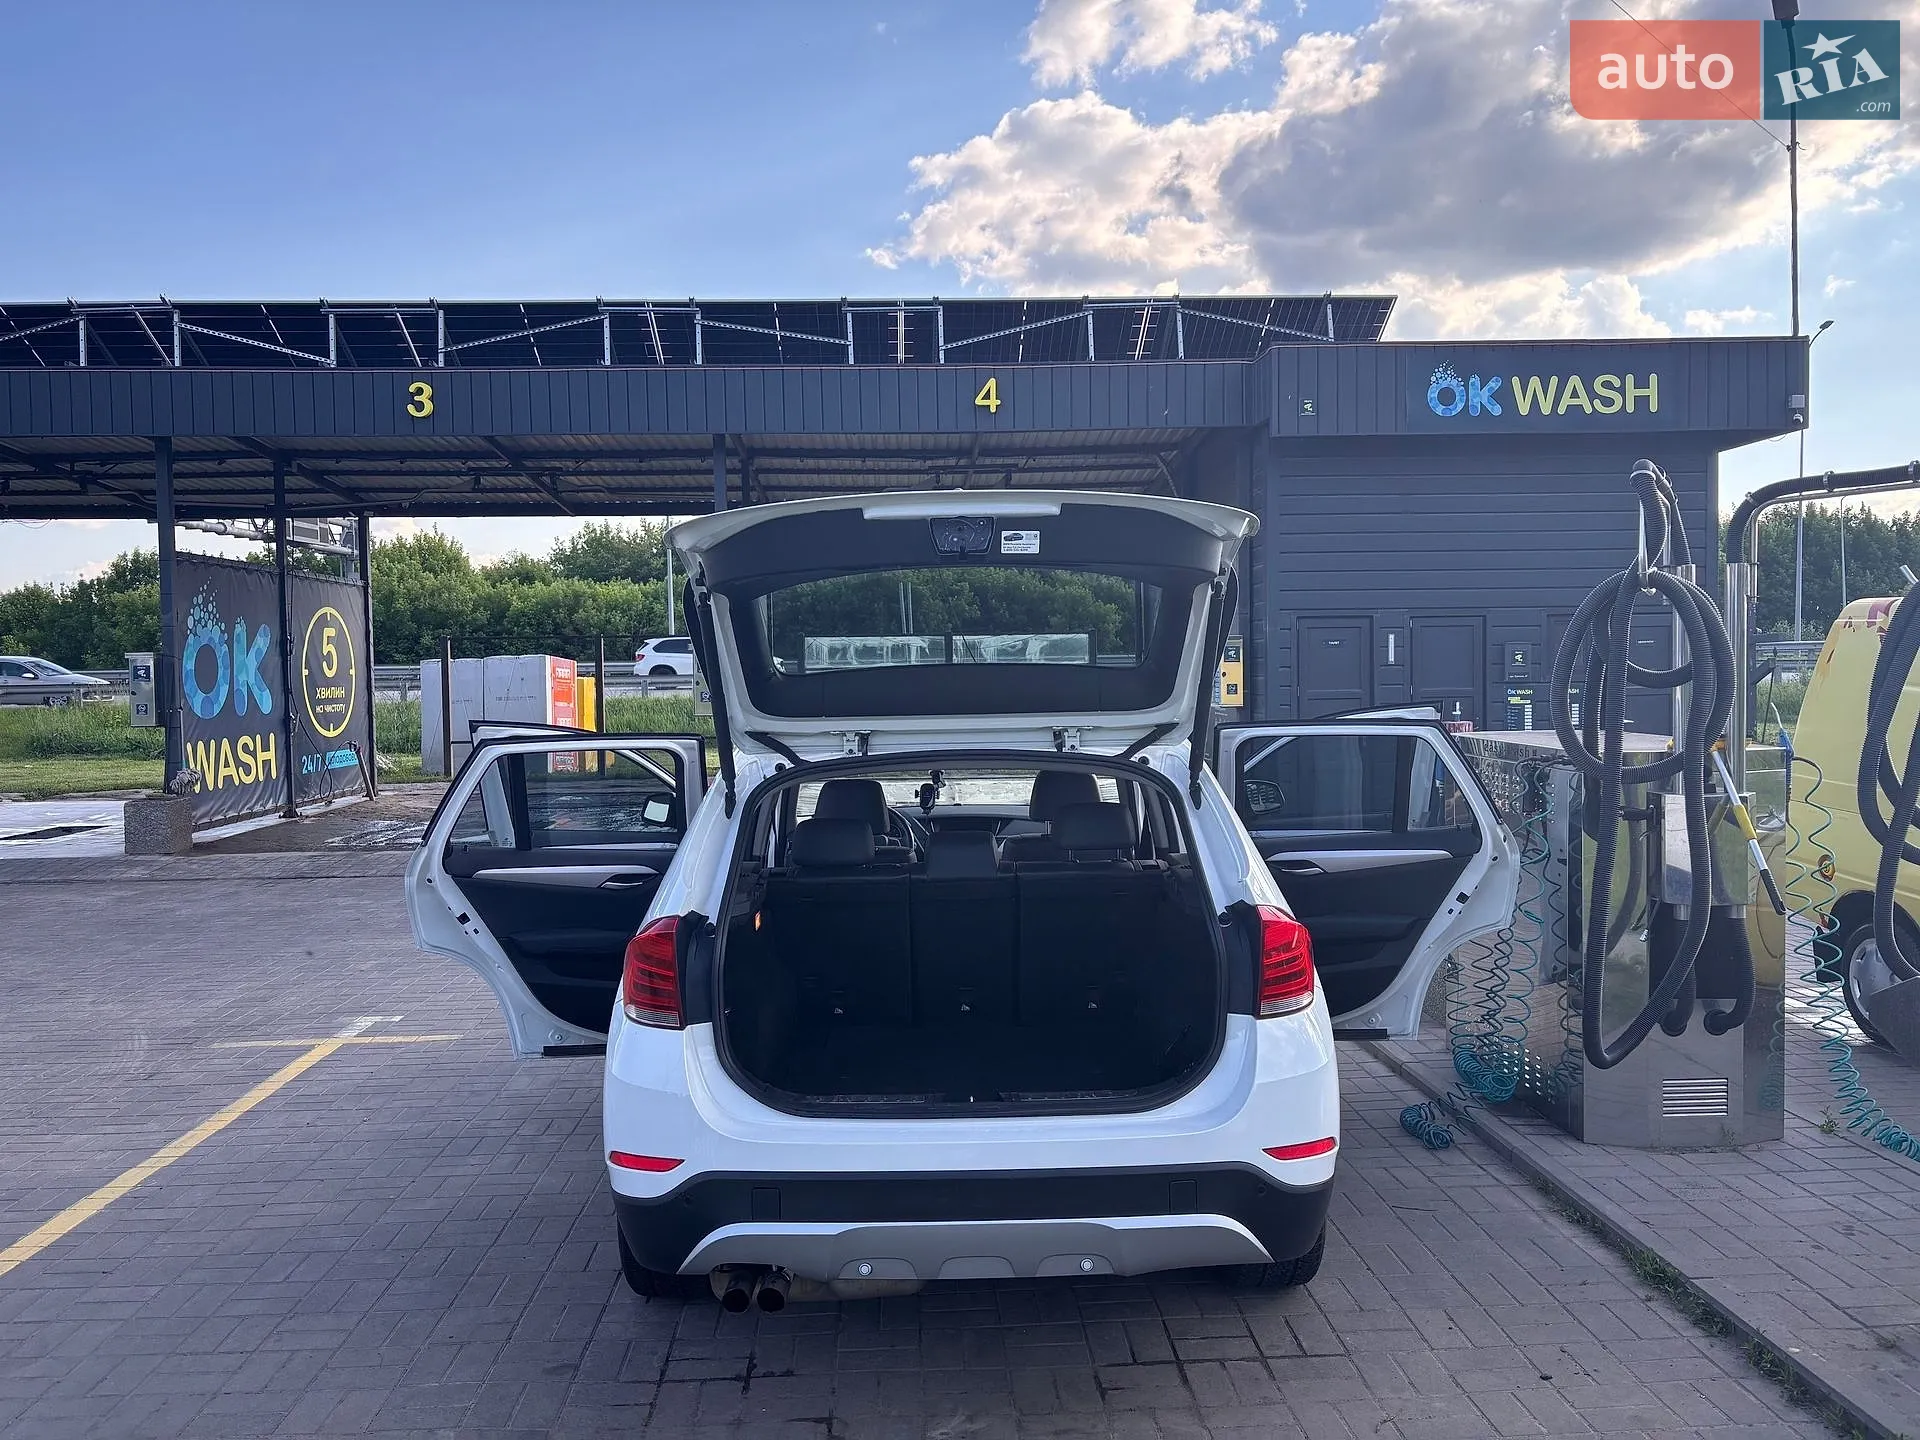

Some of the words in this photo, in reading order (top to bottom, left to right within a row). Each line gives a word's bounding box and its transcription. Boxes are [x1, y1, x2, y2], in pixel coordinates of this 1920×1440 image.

[407, 382, 434, 417] 3
[975, 378, 1001, 413] 4
[1427, 370, 1502, 417] OK
[1511, 373, 1658, 416] WASH
[183, 608, 273, 720] OK
[322, 627, 338, 678] 5
[315, 686, 345, 700] ХВИЛИН
[186, 732, 277, 794] WASH
[301, 753, 322, 775] 24/7
